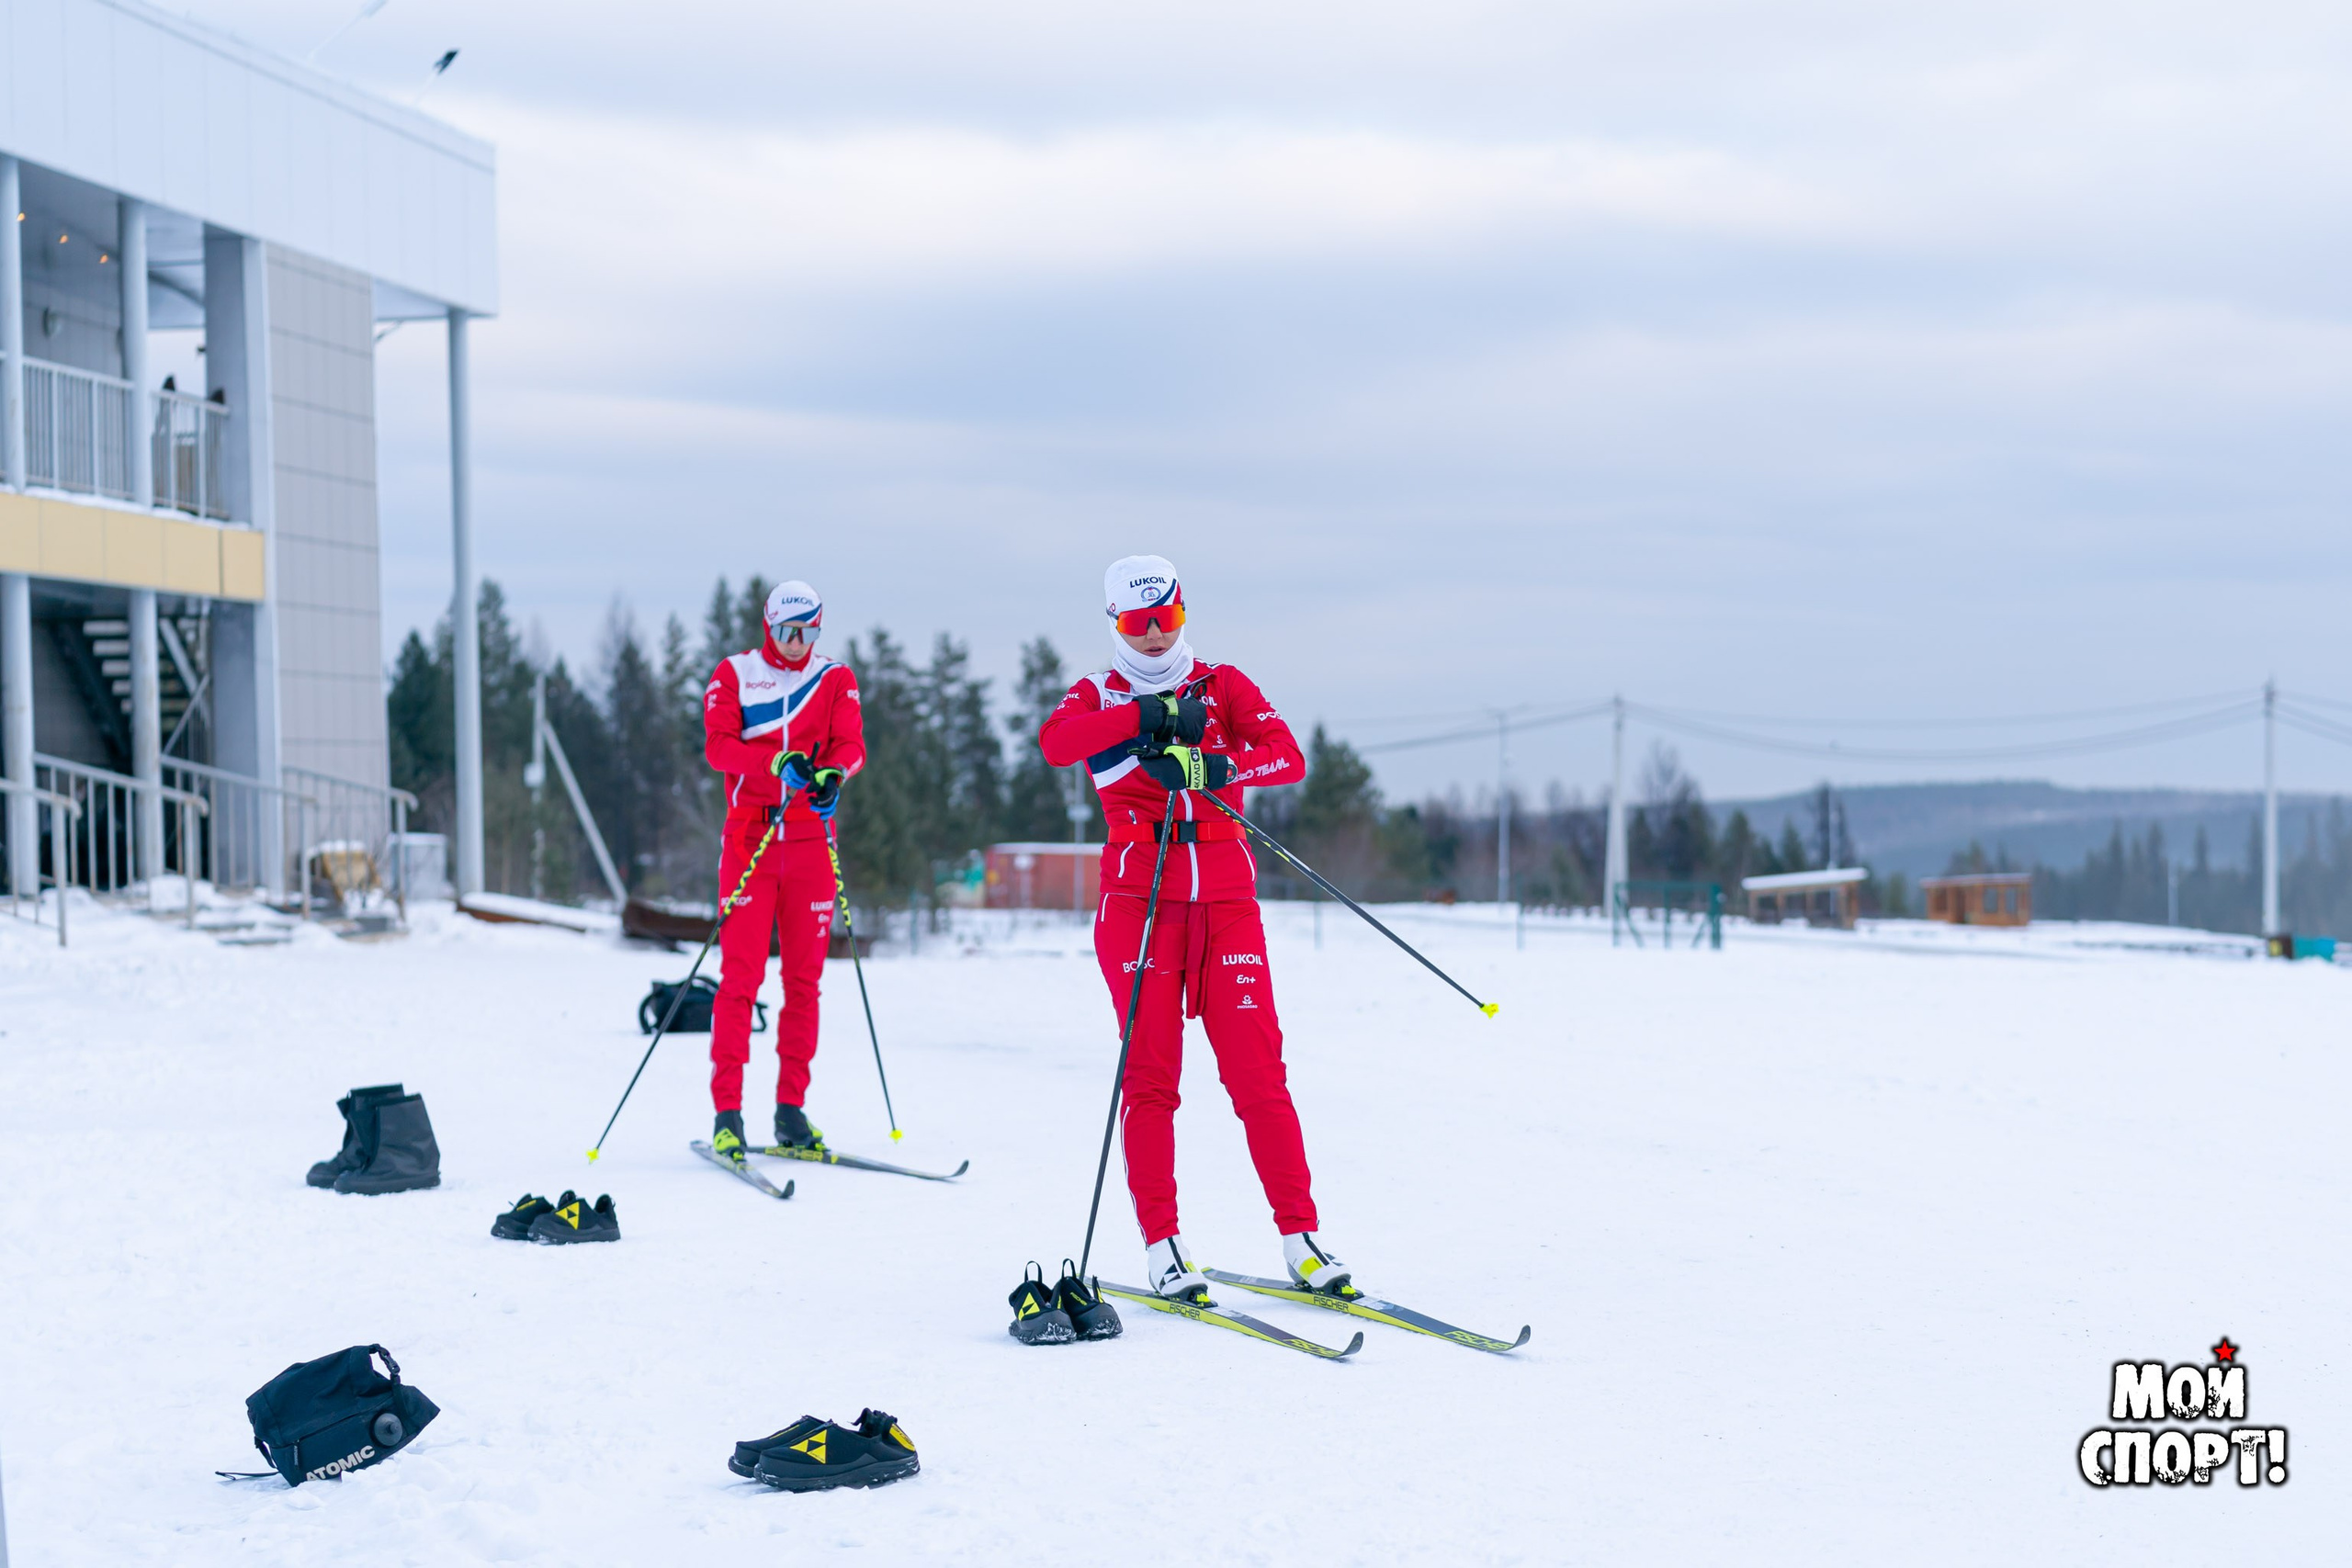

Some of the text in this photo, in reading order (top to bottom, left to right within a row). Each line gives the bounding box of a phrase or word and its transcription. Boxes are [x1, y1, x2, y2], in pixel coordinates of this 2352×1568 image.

[1129, 576, 1167, 588] LUKOIL
[781, 597, 815, 607] LUKOIL
[1222, 953, 1263, 965] LUKOIL
[1169, 1303, 1201, 1319] FISCHER
[1313, 1296, 1350, 1312] FISCHER
[306, 1445, 376, 1482] ATOMIC
